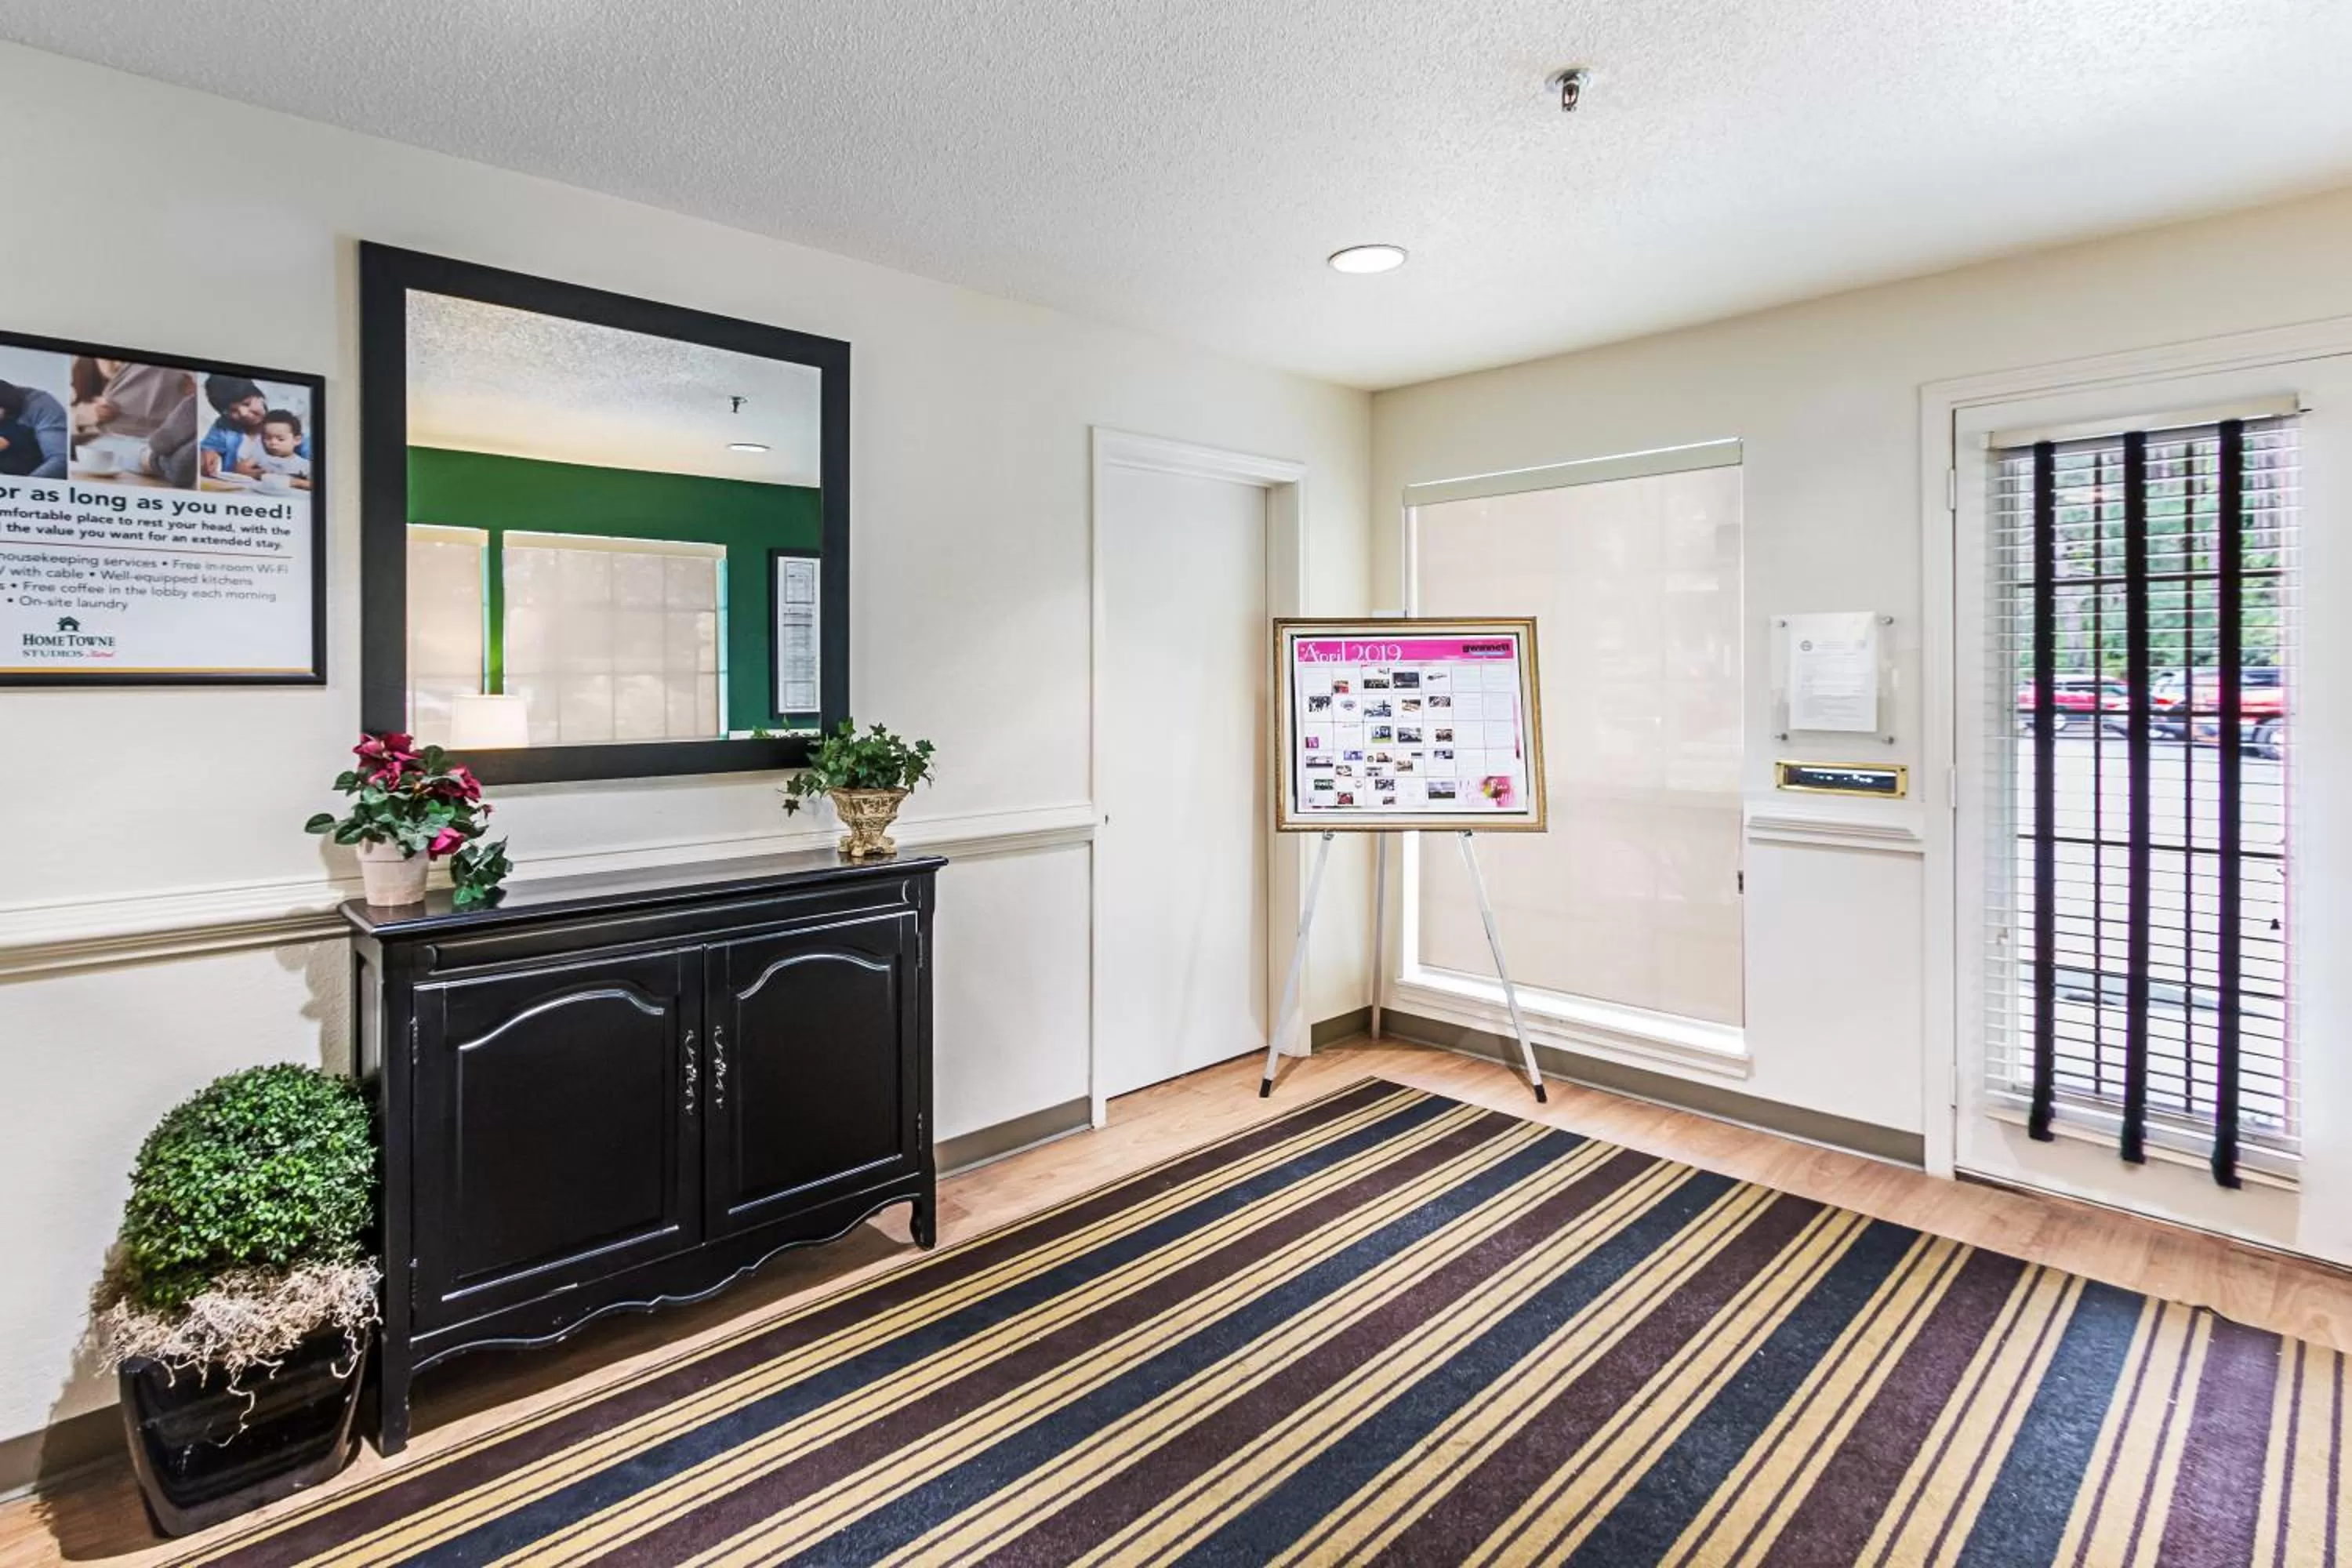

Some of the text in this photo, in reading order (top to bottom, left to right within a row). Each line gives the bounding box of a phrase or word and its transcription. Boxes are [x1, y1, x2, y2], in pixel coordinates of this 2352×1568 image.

[30, 488, 60, 503] as
[69, 486, 127, 512] long
[136, 498, 163, 510] as
[172, 499, 217, 517] you
[226, 503, 292, 520] need!
[77, 512, 114, 524] place
[118, 517, 132, 525] to
[137, 518, 163, 528] rest
[167, 521, 197, 531] your
[240, 524, 267, 535] with
[271, 526, 291, 536] the
[5, 522, 31, 533] the
[36, 524, 74, 536] value
[79, 528, 105, 539] you
[110, 531, 144, 540] want
[148, 532, 167, 541] for
[191, 536, 252, 547] extended
[103, 557, 158, 568] services
[172, 559, 201, 570] Free
[205, 561, 253, 572] in-room
[256, 564, 289, 575] Wi-Fi
[9, 567, 41, 576] with
[45, 568, 84, 579] cable
[100, 570, 198, 585] Well-equipped
[201, 574, 253, 586] kitchens
[23, 581, 56, 593] Free
[60, 583, 105, 594] coffee
[109, 585, 121, 594] in
[125, 586, 147, 596] the
[151, 587, 188, 599] lobby
[191, 590, 222, 599] each
[225, 591, 277, 603] morning
[19, 595, 128, 611] On-site laundry
[1351, 644, 1403, 662] 2019
